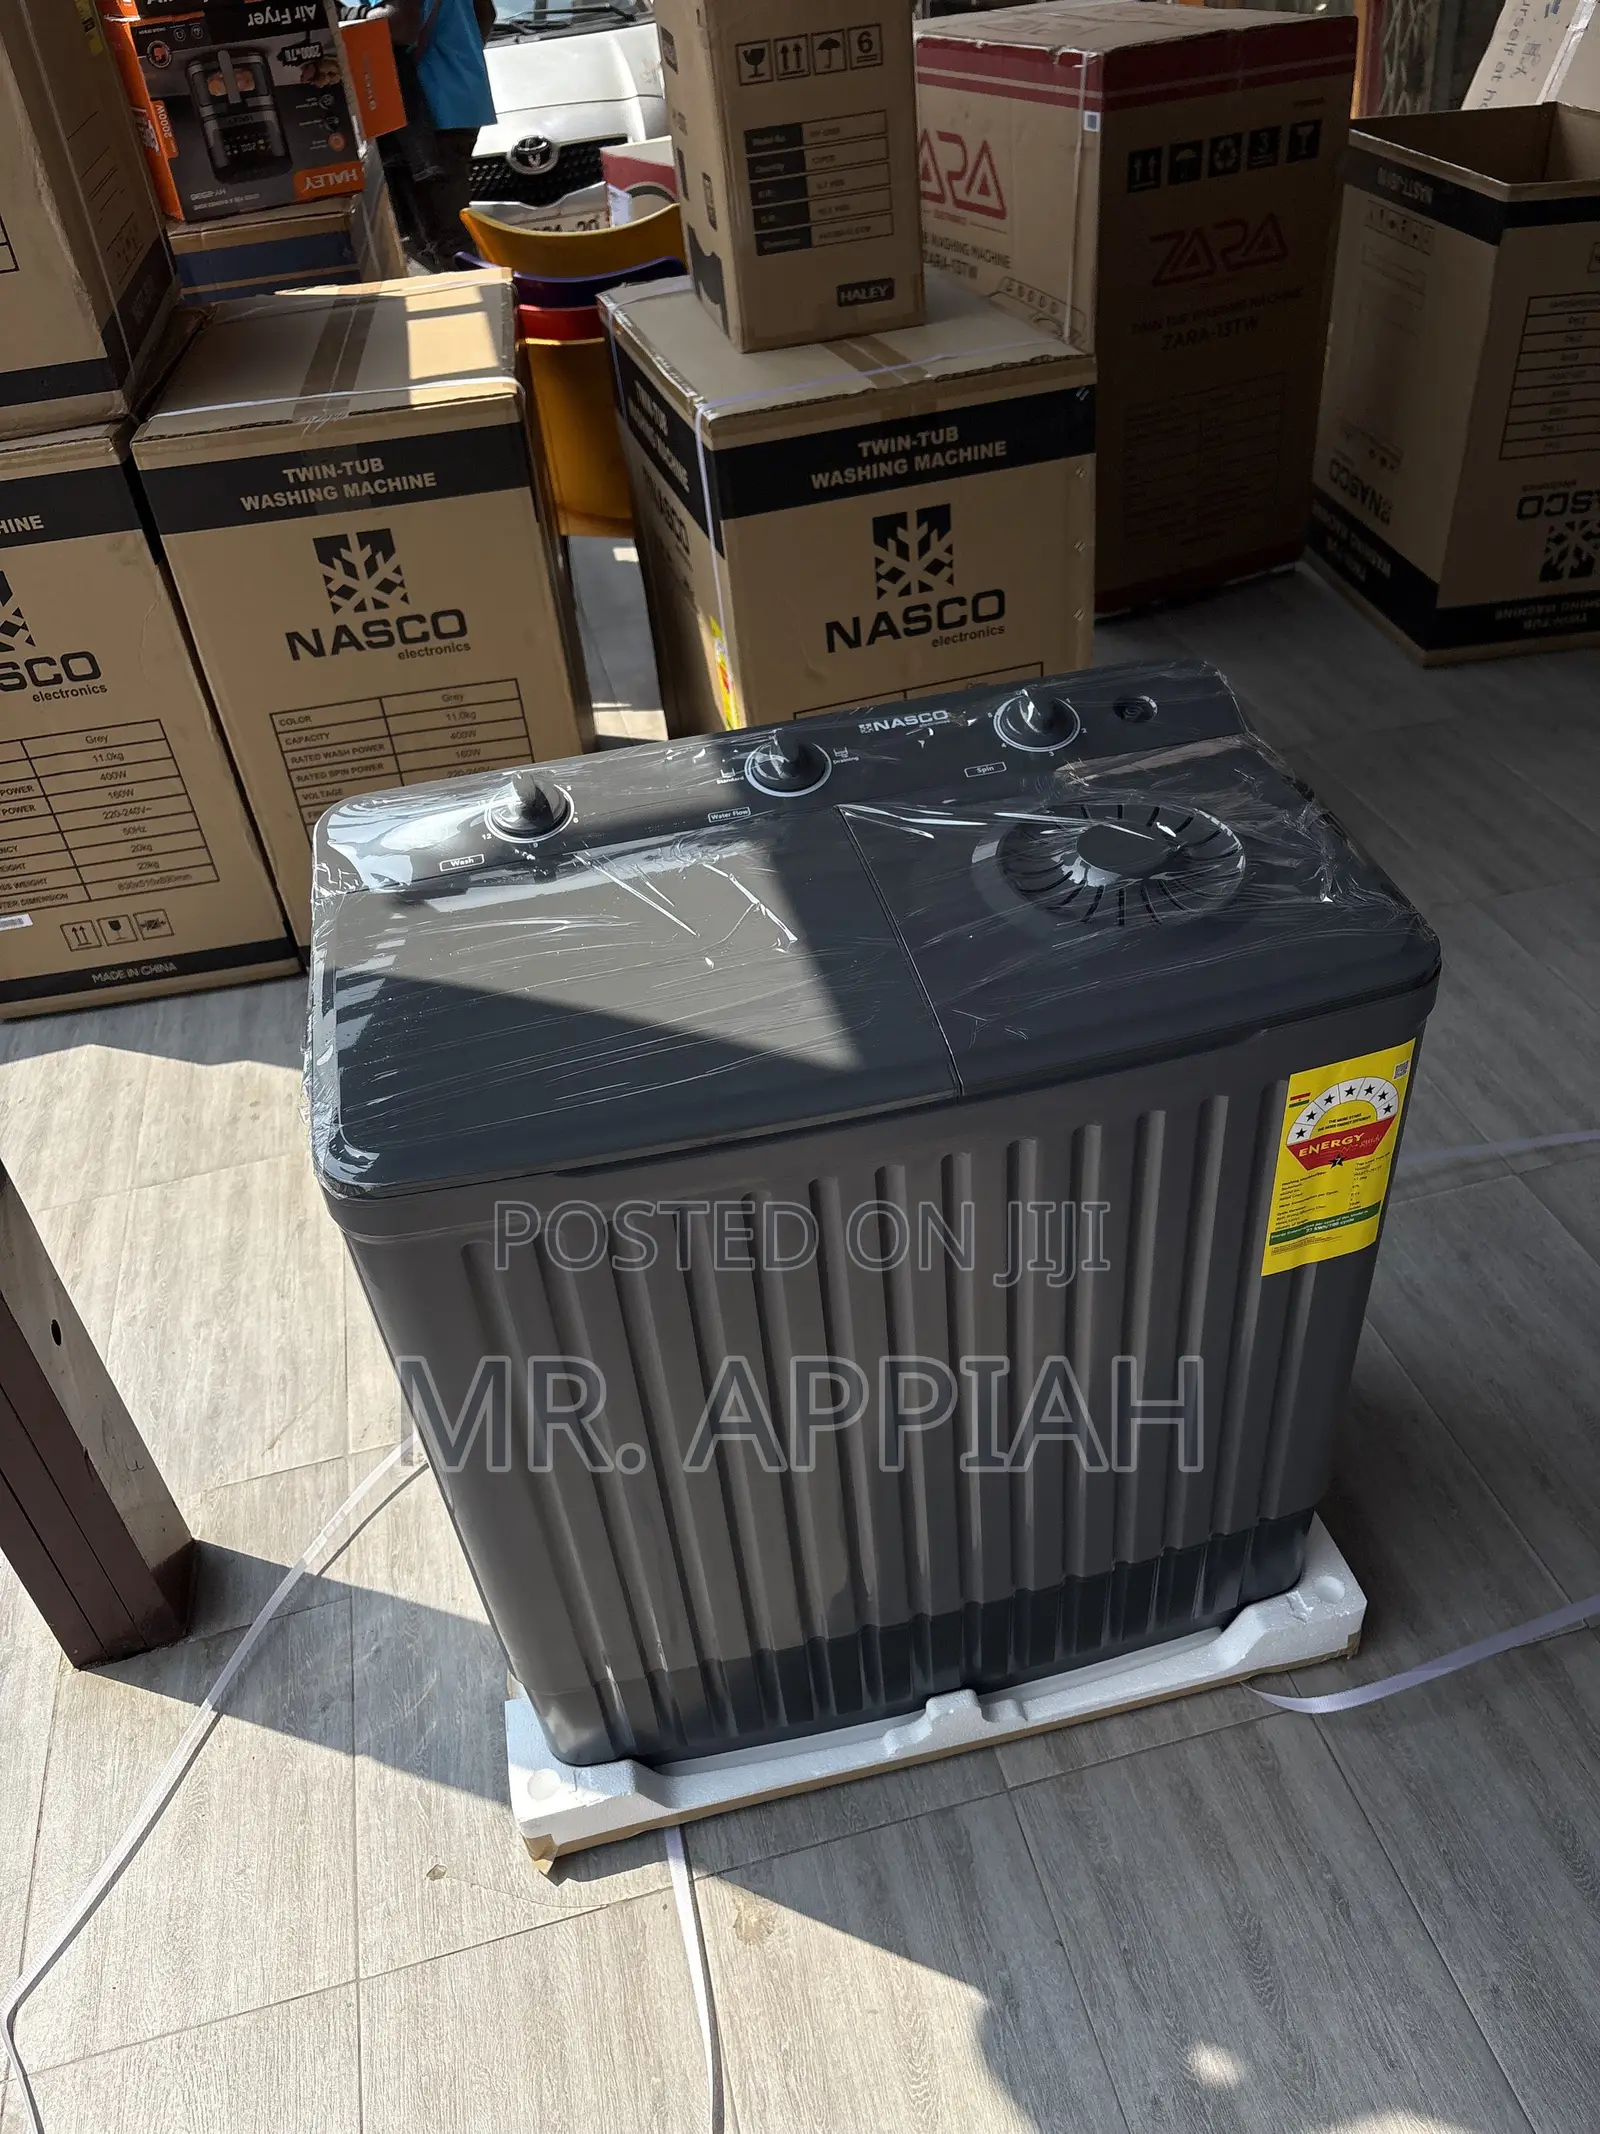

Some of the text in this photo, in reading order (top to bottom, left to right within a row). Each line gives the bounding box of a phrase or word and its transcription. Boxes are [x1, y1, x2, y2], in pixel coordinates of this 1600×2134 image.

[247, 3, 316, 28] Air Fryer
[856, 31, 873, 54] 6
[155, 103, 172, 138] 2000W
[303, 168, 360, 192] HALEY
[1149, 212, 1289, 287] ZARA
[839, 284, 889, 303] HALEY
[857, 425, 960, 459] TWIN-TUB
[282, 456, 385, 484] TWIN-TUB
[810, 440, 1008, 490] WASHING MACHINE
[239, 471, 438, 512] WASHING MACHINE
[1516, 488, 1600, 525] SCO
[825, 588, 1006, 653] NASCO
[285, 608, 468, 661] NASCO
[931, 623, 1006, 648] electronics
[397, 640, 472, 660] electronics
[32, 684, 108, 703] electronics
[278, 714, 312, 727] COLOR
[284, 709, 477, 746] CAPACITY 11.0kg
[873, 710, 949, 738] NASCO
[92, 752, 125, 764] 11.0kg
[290, 752, 322, 765] RATED
[323, 748, 351, 760] WASH
[351, 743, 386, 757] POWER
[100, 770, 127, 781] 400W
[296, 769, 328, 783] RATED
[350, 762, 385, 776] POWER
[976, 763, 996, 774] Spin
[716, 776, 745, 785] Standard
[301, 787, 344, 801] VOLTAGE
[1, 803, 37, 816] POWER
[711, 807, 750, 822] Water Flow
[481, 833, 493, 841] 12
[450, 855, 475, 867] Wash
[91, 961, 178, 984] MADE IN CHINA
[1298, 1132, 1366, 1158] ENERGY
[1335, 1157, 1341, 1165] 7
